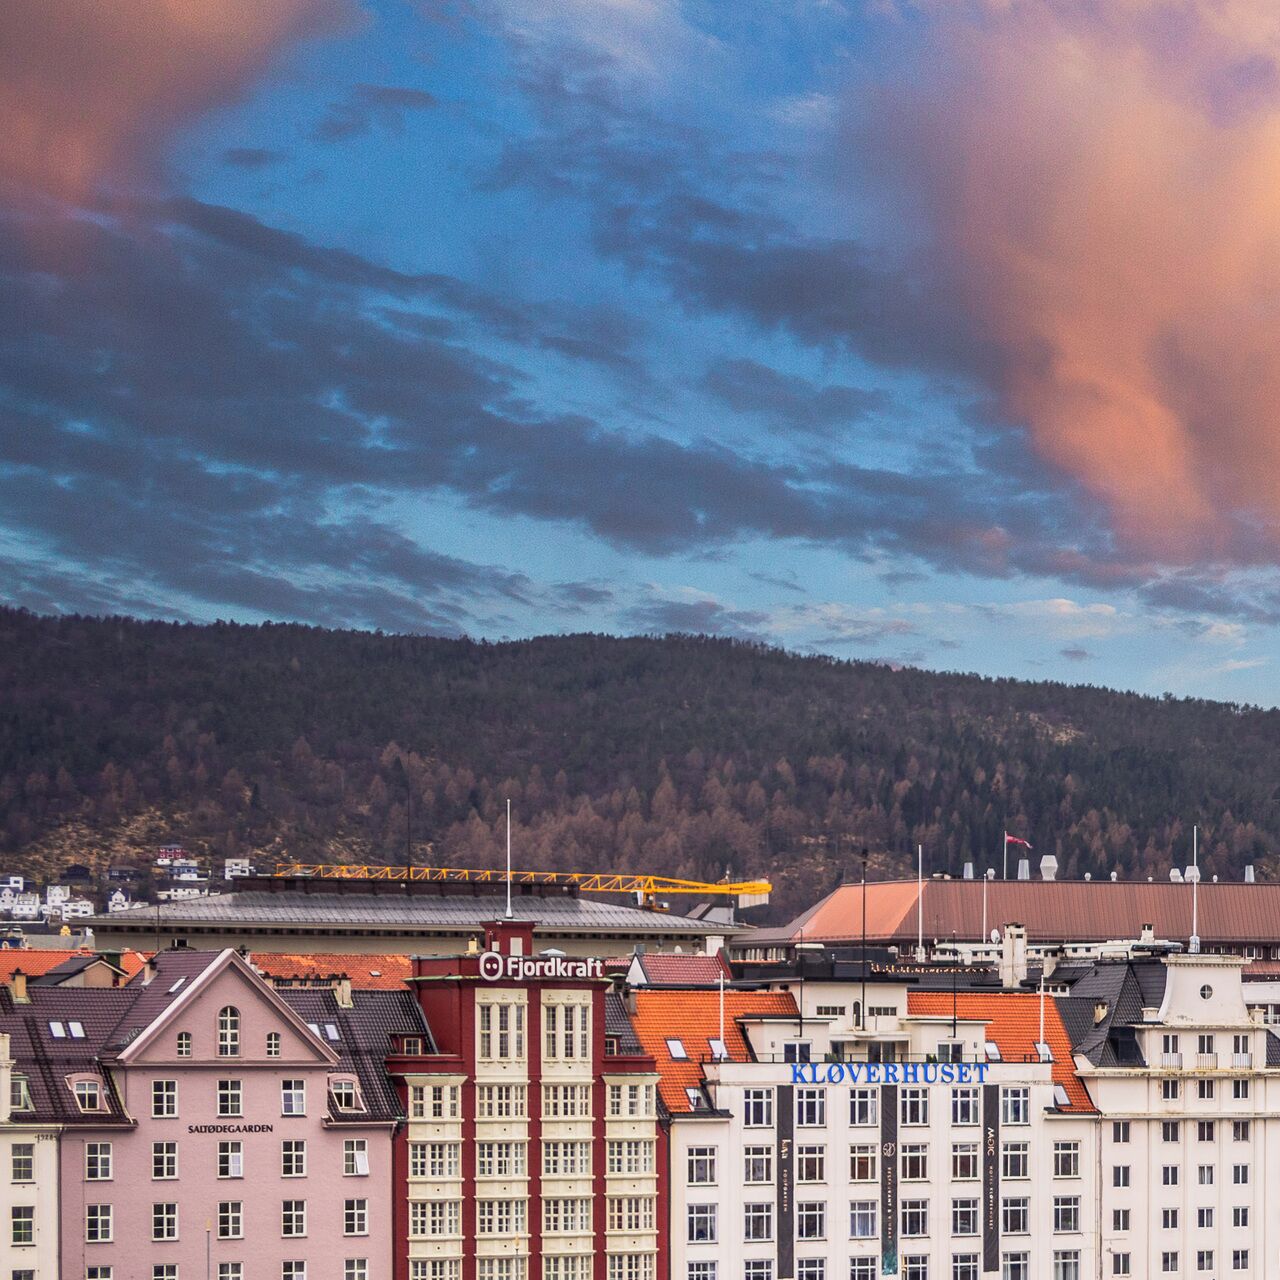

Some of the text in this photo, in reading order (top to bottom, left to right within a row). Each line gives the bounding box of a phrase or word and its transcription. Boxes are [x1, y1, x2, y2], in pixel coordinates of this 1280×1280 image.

[507, 957, 603, 980] Fjordkraft
[791, 1063, 989, 1084] KLØVERHUSET
[188, 1125, 273, 1134] SALTØDEGAARDEN
